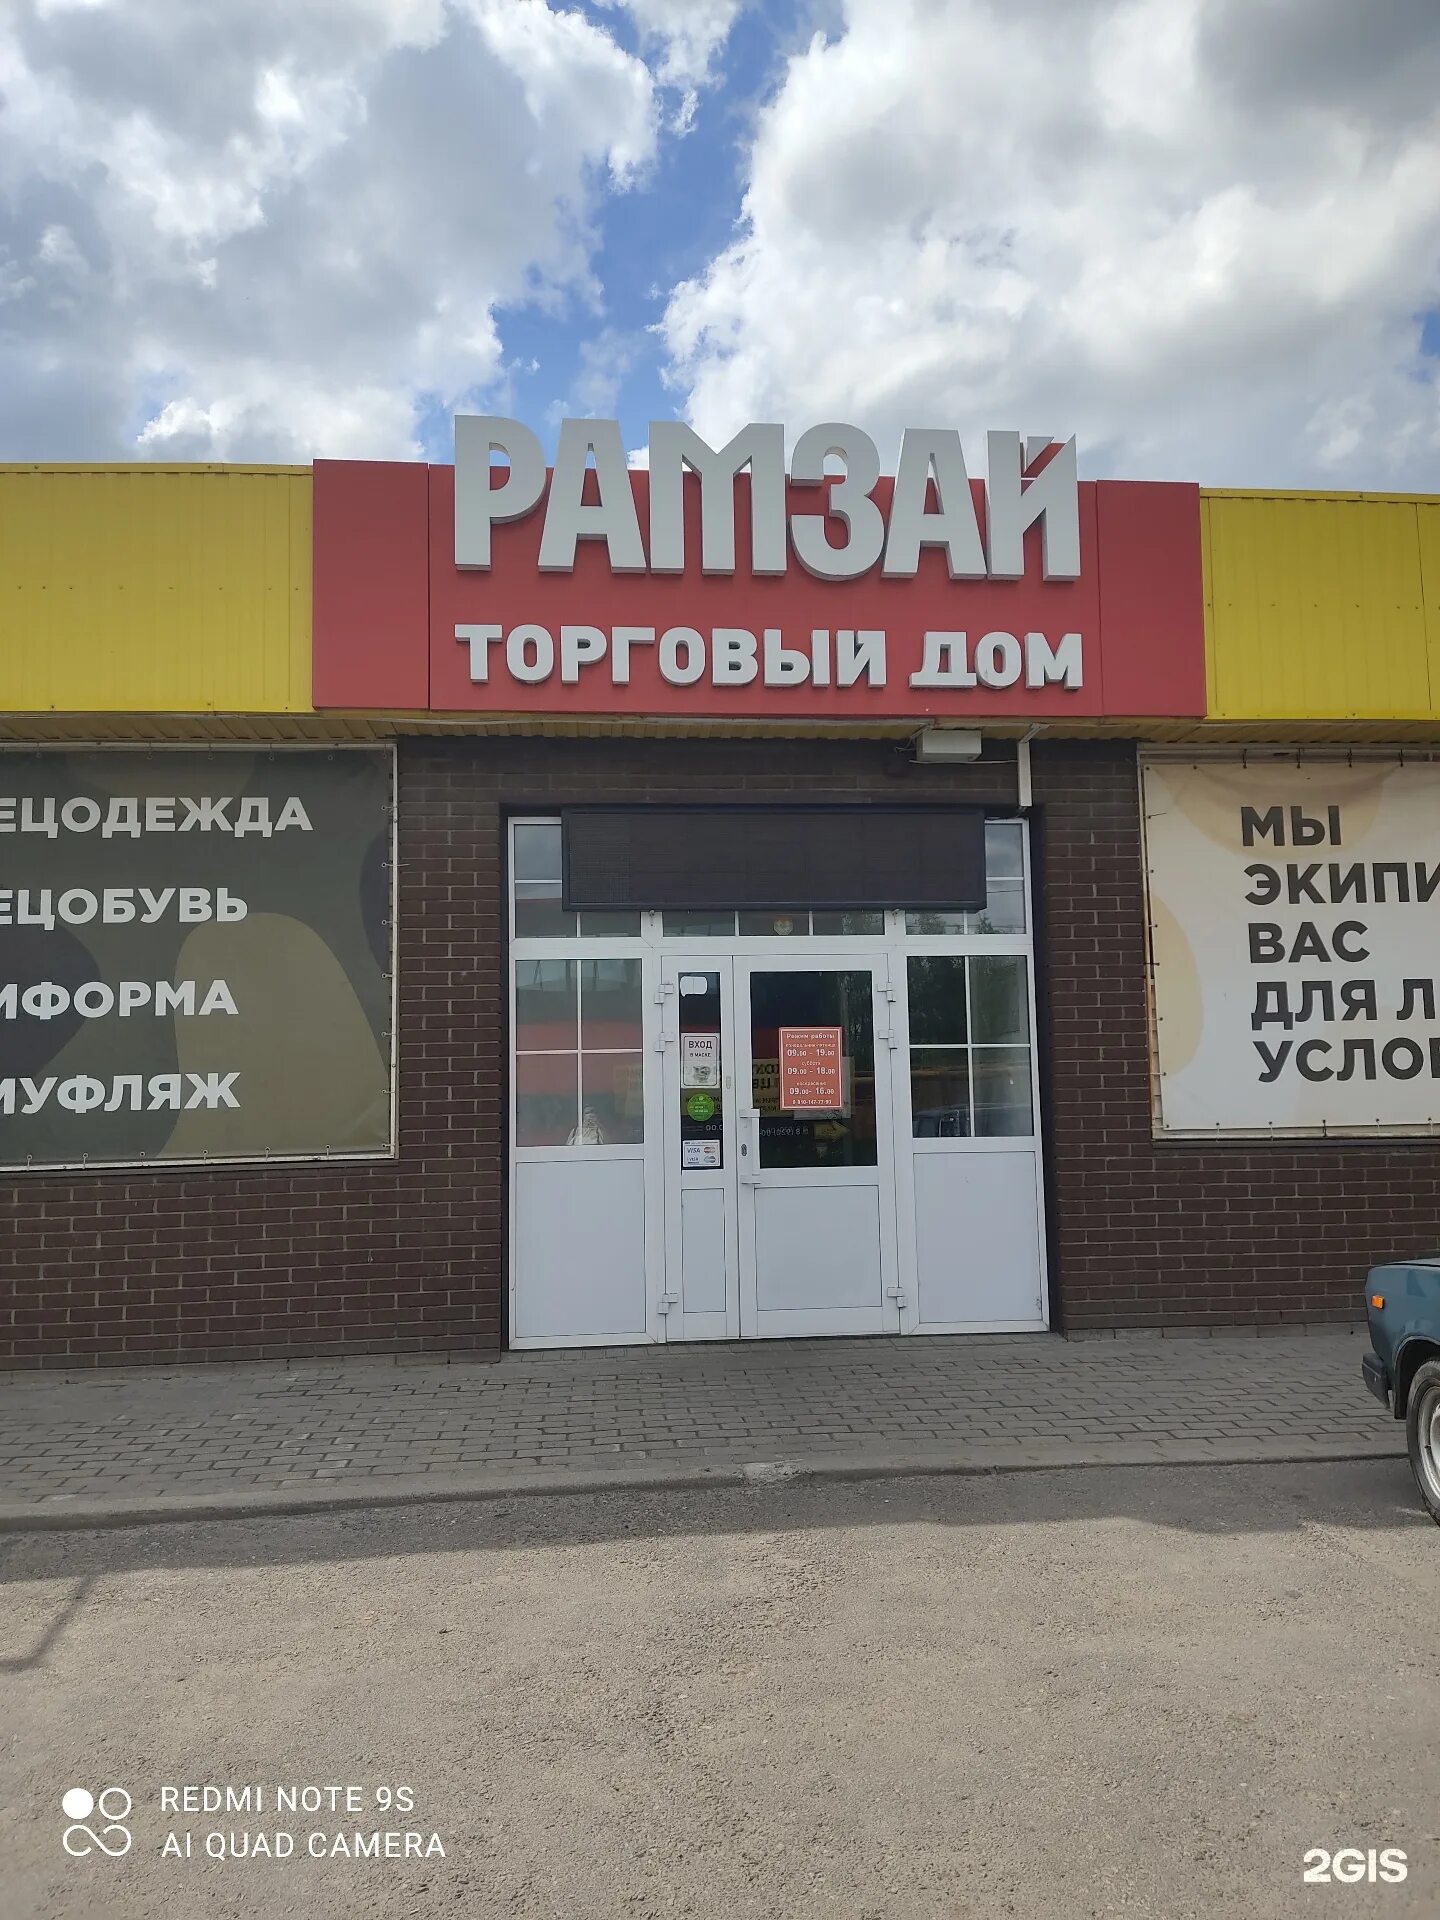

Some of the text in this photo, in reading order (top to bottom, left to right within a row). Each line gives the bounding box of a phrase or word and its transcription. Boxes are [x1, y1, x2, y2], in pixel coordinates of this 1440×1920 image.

[454, 414, 1081, 582] РАМЗАЙ
[454, 623, 1084, 690] ТОРГОВЫЙ ДОМ
[1241, 805, 1342, 846] МЫ
[1248, 920, 1371, 964] ВАС
[1251, 979, 1378, 1031] ДЛЯ
[688, 1041, 712, 1049] ВХОД
[816, 1048, 835, 1056] 19.00
[815, 1086, 835, 1095] 16.00
[816, 1066, 836, 1075] 18.00
